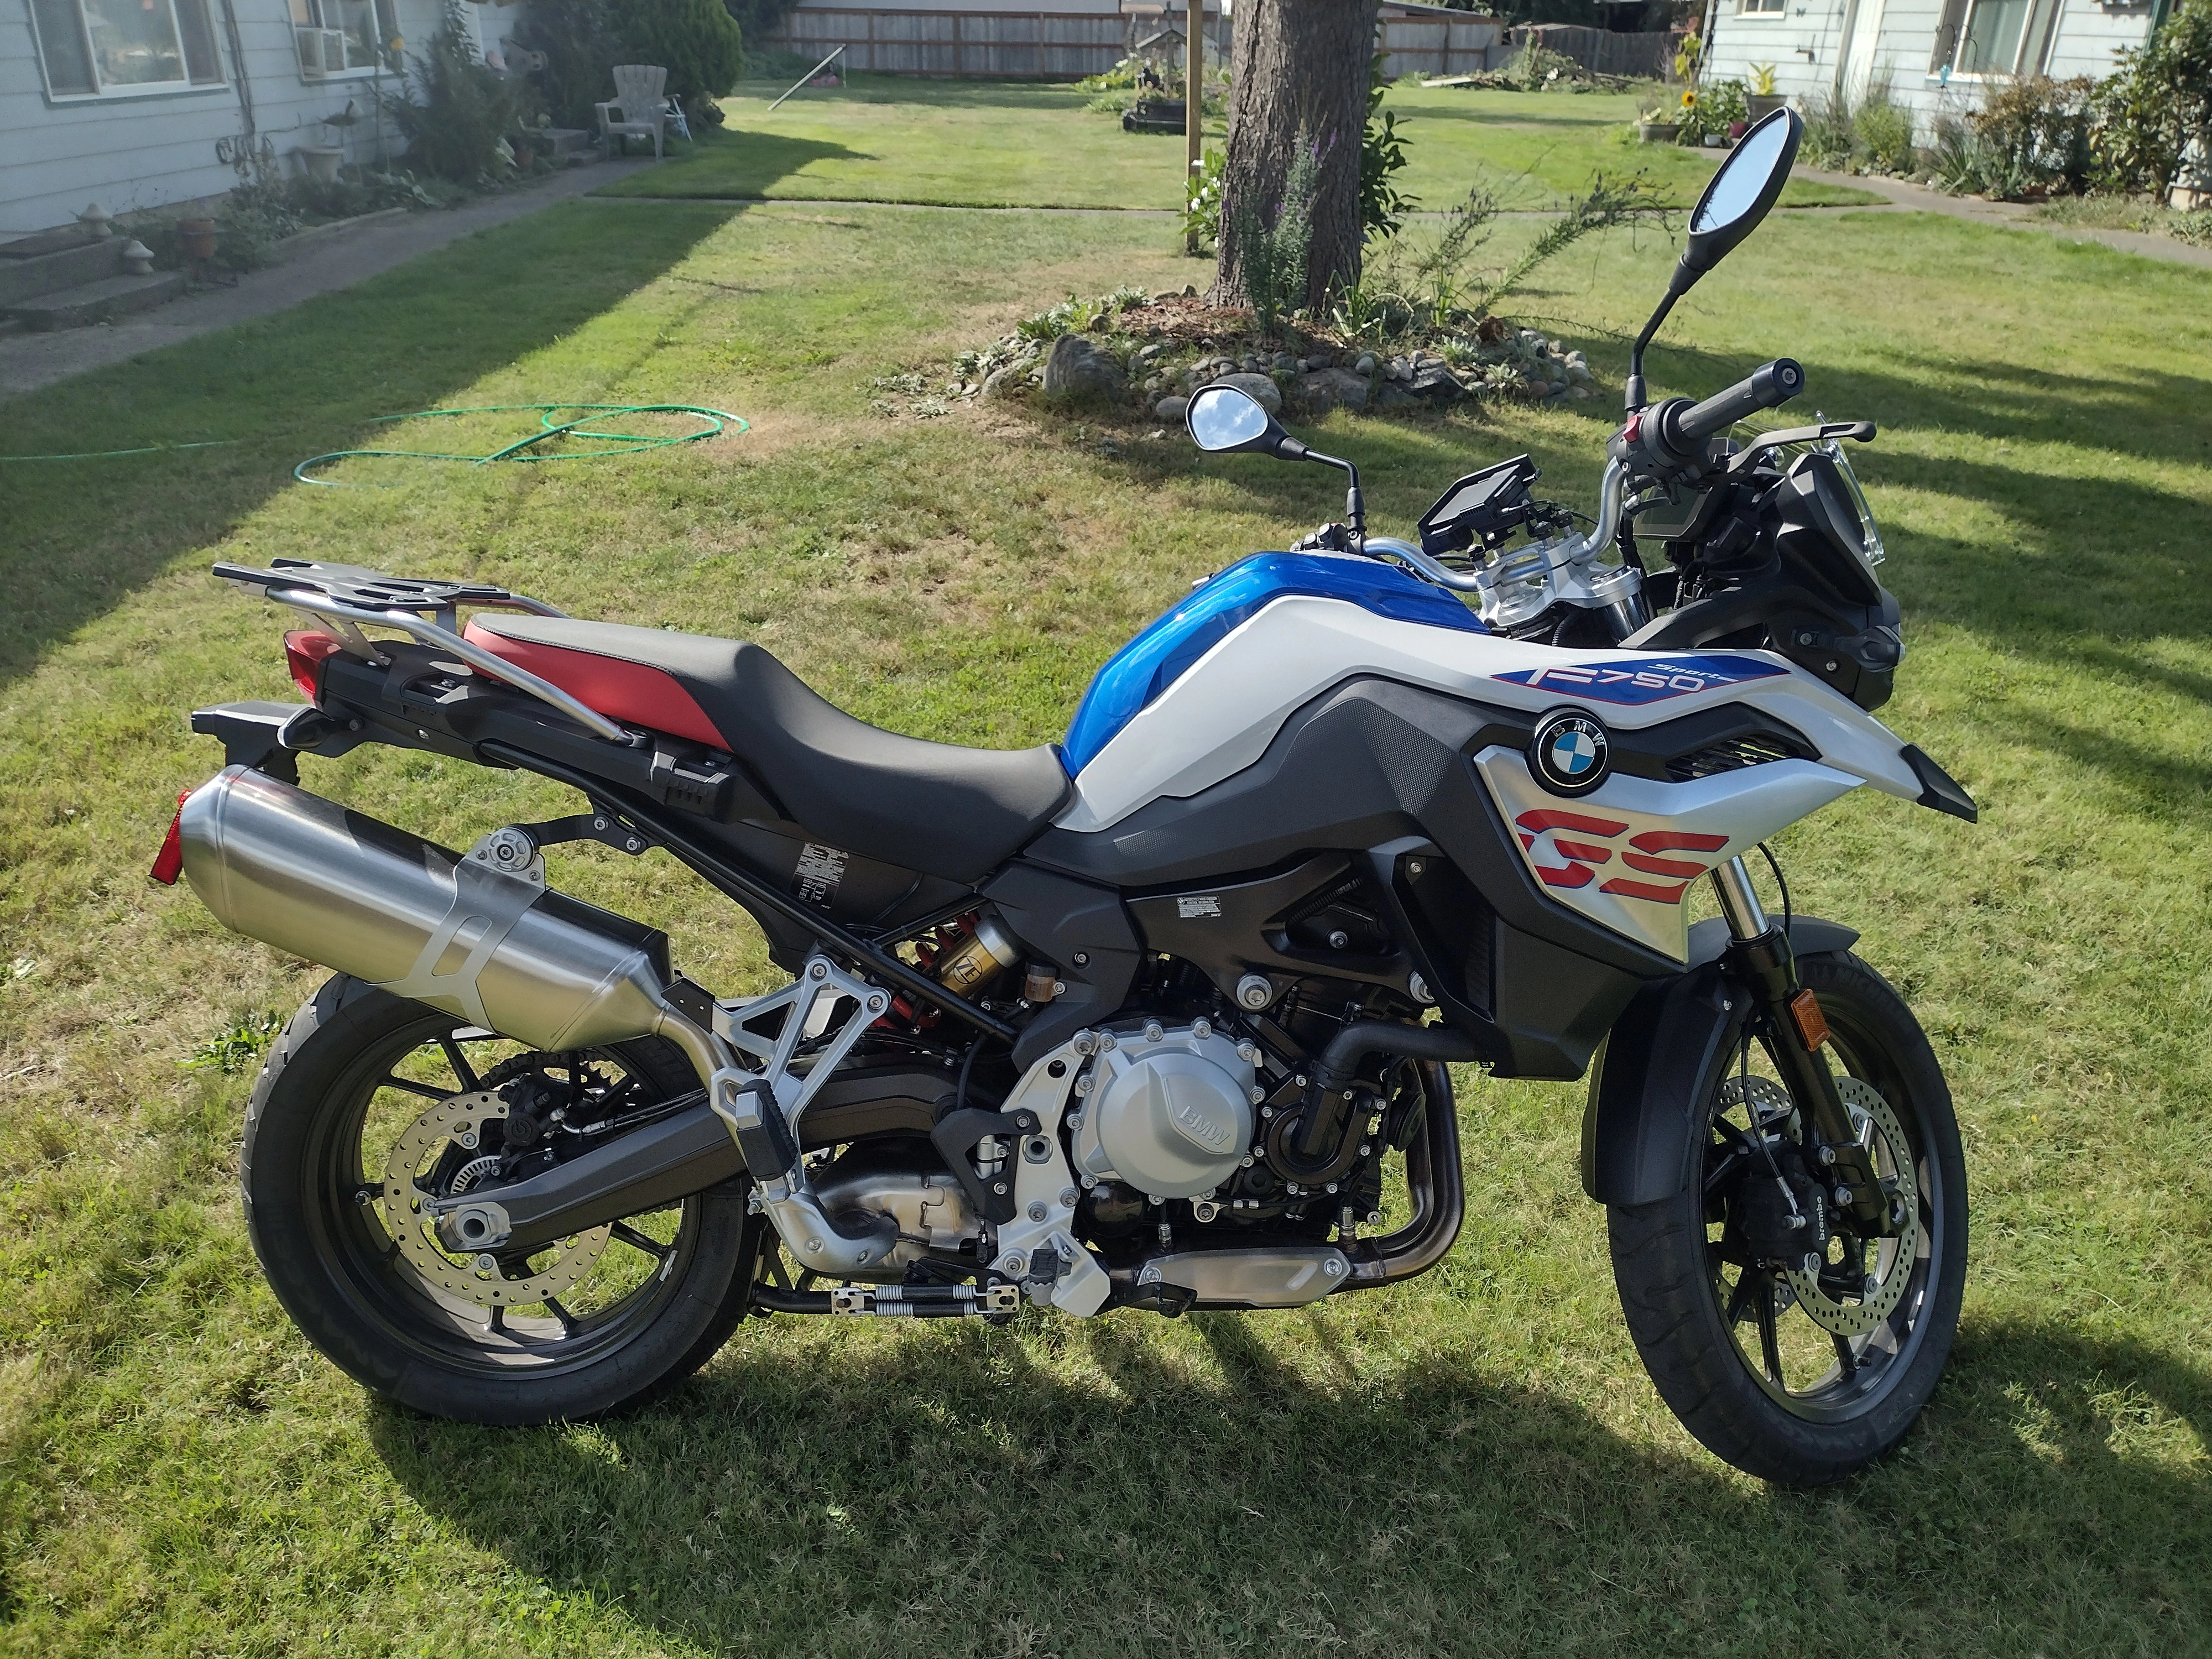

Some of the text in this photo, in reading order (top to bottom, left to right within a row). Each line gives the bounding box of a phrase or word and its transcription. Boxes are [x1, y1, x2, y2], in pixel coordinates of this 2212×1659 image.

[1526, 665, 1705, 692] F750
[1647, 664, 1738, 682] Sport
[1551, 720, 1605, 747] BMW
[1515, 809, 1730, 905] GS
[953, 956, 983, 984] ZF
[1179, 1105, 1230, 1146] BMW
[1816, 1196, 1825, 1240] brembo
